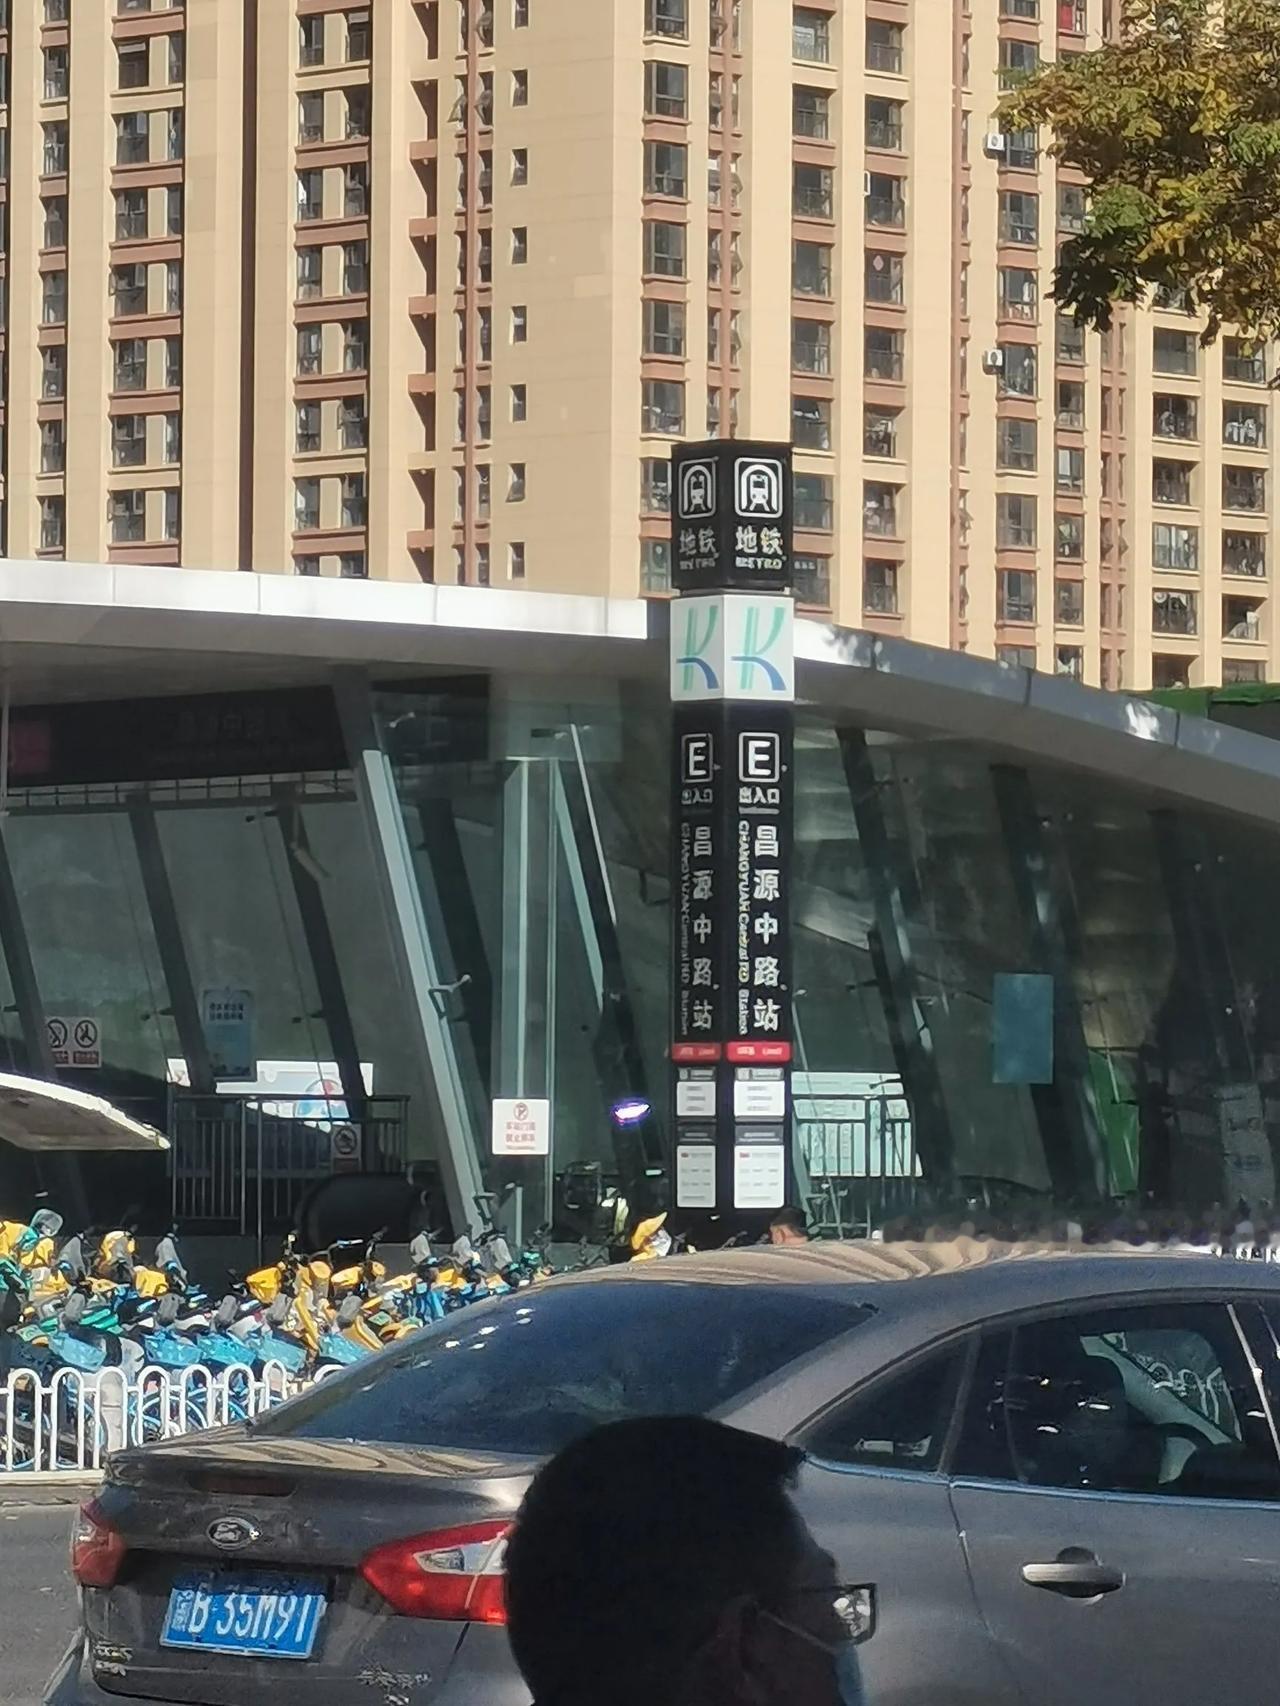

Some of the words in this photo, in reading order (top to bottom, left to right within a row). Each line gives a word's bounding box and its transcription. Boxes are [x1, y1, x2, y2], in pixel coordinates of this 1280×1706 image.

[735, 525, 783, 555] 地铁
[688, 741, 707, 776] E
[748, 740, 772, 776] E
[753, 825, 781, 1032] 昌源中路站
